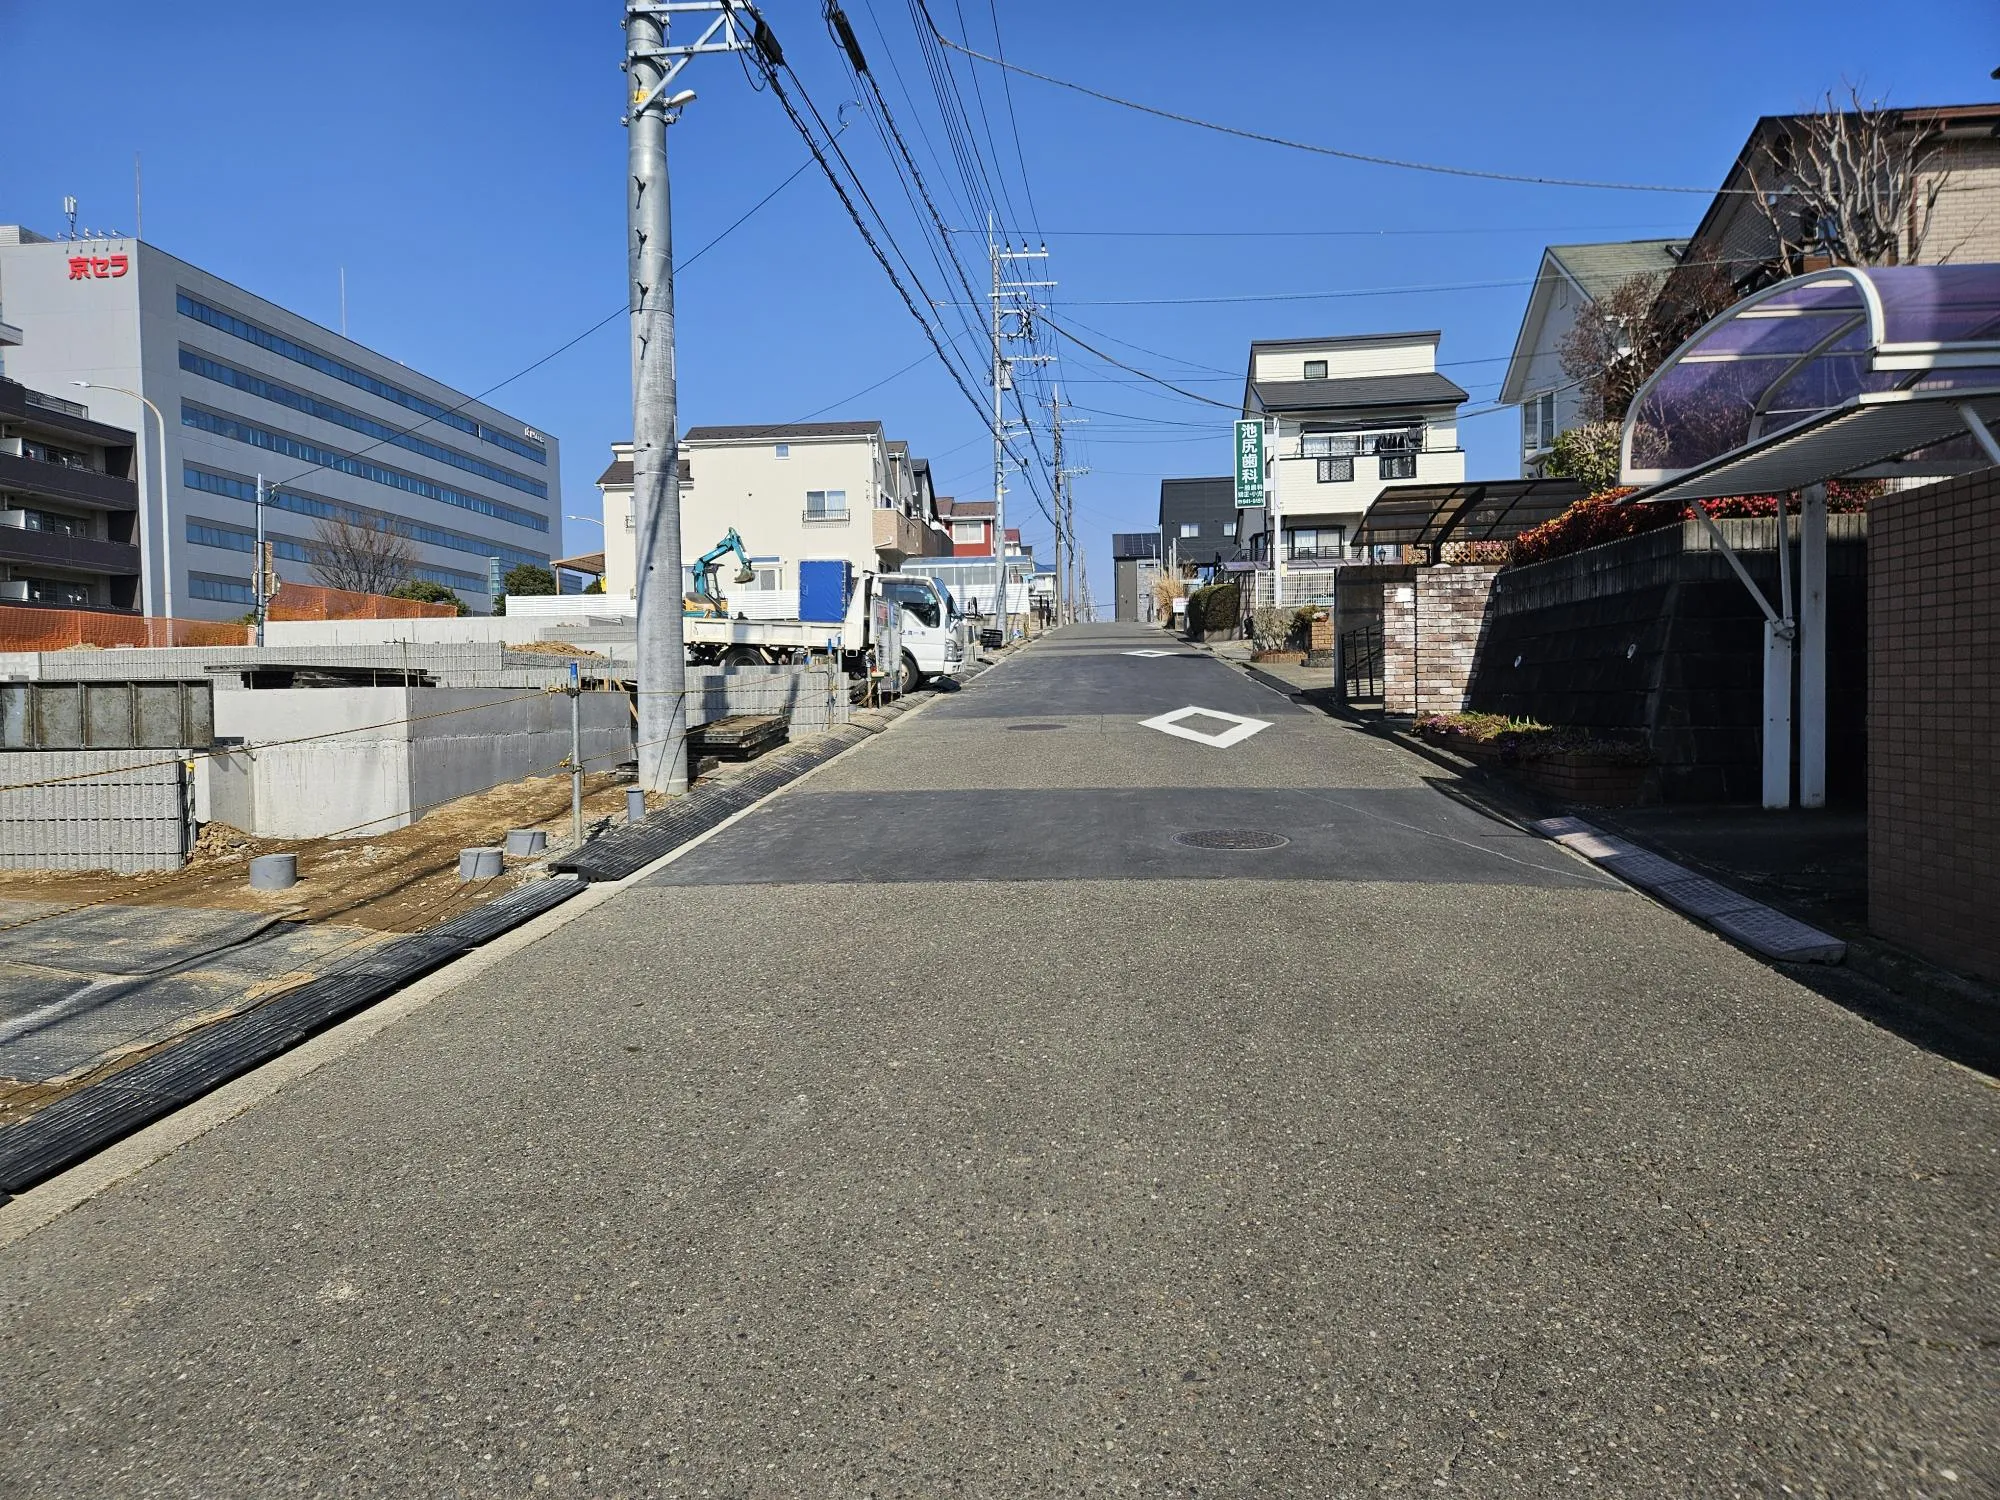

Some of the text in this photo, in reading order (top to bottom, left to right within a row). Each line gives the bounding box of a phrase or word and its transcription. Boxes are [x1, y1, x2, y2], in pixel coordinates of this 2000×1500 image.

[68, 255, 129, 280] 京セラ
[1241, 423, 1258, 484] 池尻歯科
